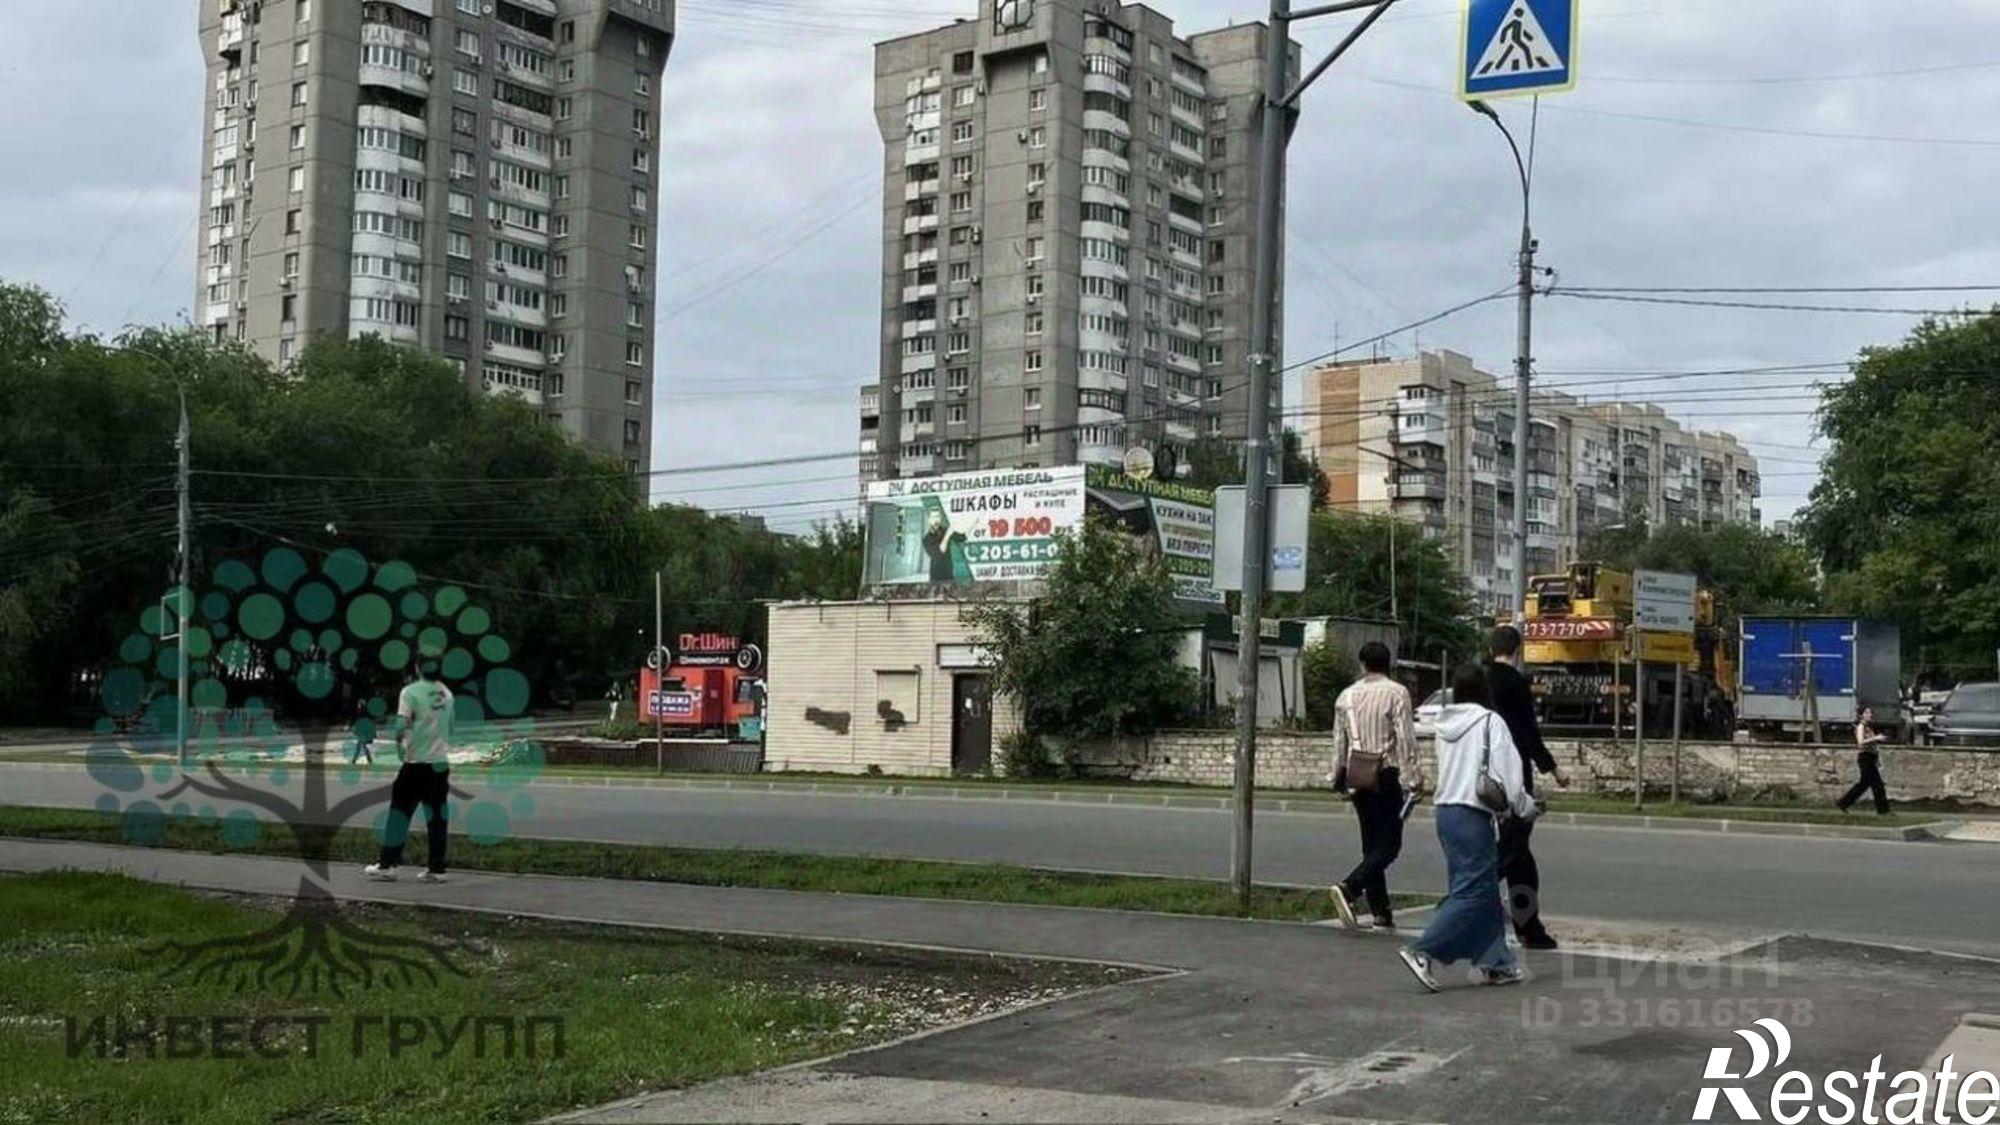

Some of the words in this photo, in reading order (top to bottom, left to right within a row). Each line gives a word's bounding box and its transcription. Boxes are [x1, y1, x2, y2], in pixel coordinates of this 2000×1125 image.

[911, 475, 991, 494] ДОСТУПНАЯ
[994, 472, 1054, 487] МЕБЕЛЬ
[950, 493, 1017, 513] ШКАФЫ
[988, 519, 1009, 538] 19
[1013, 517, 1052, 536] 500
